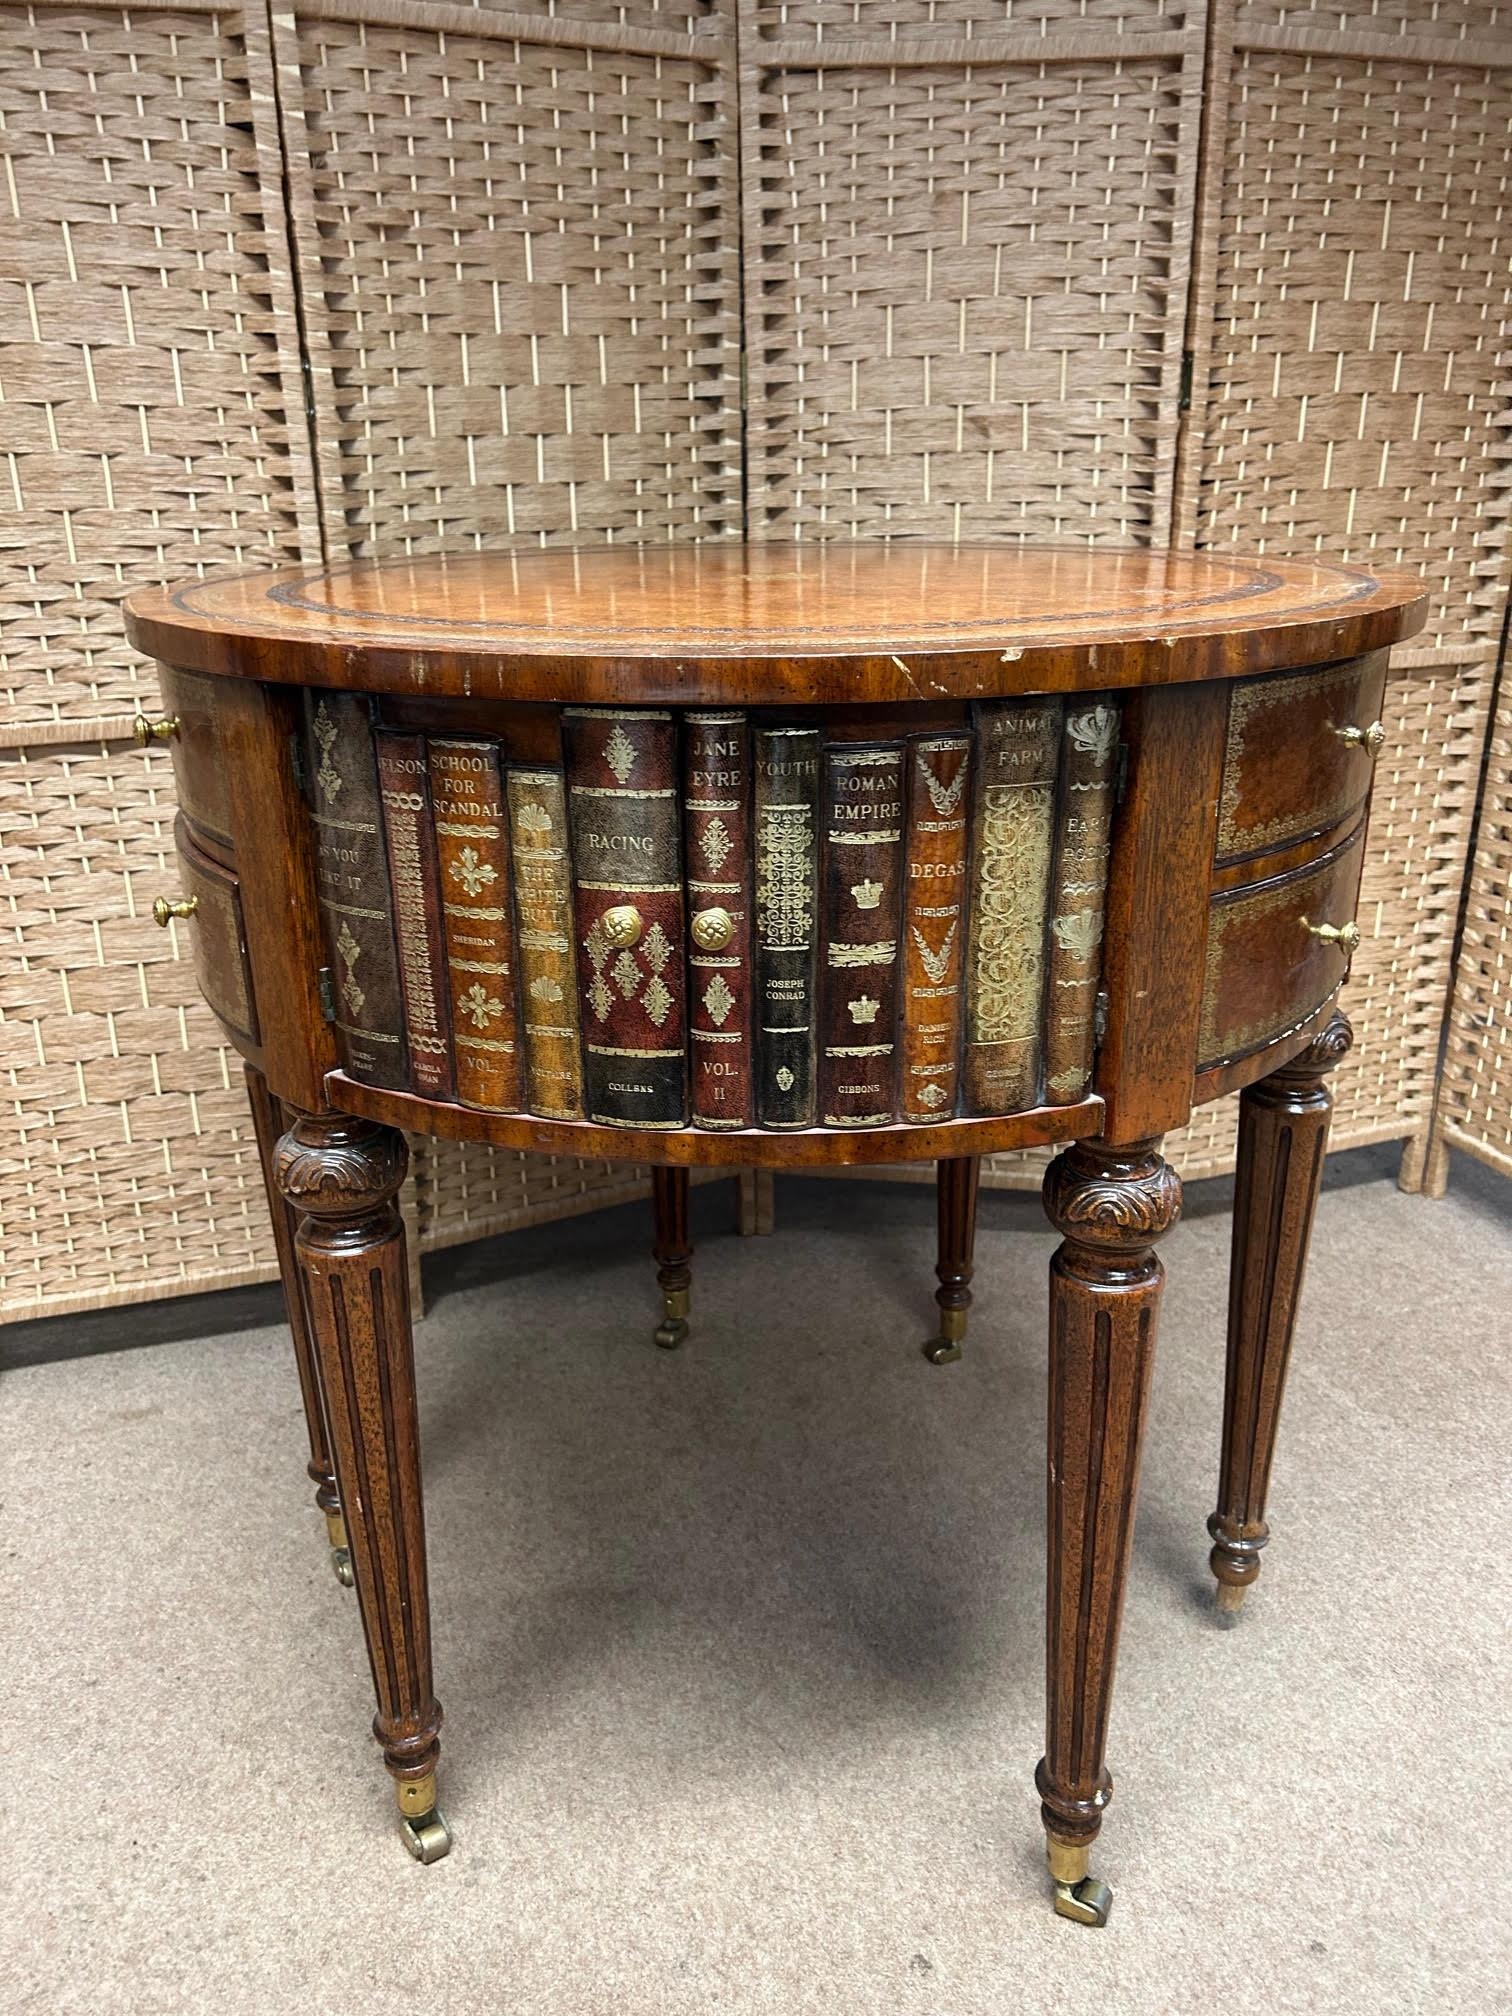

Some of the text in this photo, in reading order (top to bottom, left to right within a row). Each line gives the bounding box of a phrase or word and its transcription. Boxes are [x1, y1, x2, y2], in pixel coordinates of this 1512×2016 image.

[694, 741, 740, 756] JANE
[431, 756, 494, 772] SCHOOL
[998, 749, 1044, 766] FARM
[757, 760, 817, 776] YOUTH
[444, 778, 476, 794] FOR
[693, 771, 741, 787] EYRE
[836, 774, 898, 791] ROMAN
[433, 800, 503, 817] SCANDAL
[834, 803, 901, 819] EMPIRE
[589, 834, 654, 851] RACING
[332, 847, 360, 864] YOU
[521, 866, 554, 882] THE
[910, 861, 966, 878] DEGAS
[347, 876, 362, 889] IT
[521, 906, 562, 924] BULL
[452, 934, 496, 947] SHERIDAN
[766, 979, 804, 989] JOSEPH
[766, 991, 805, 1001] CONRAD
[703, 1062, 739, 1076] VOL.
[713, 1087, 726, 1100] II
[838, 1085, 880, 1094] GIBBONS
